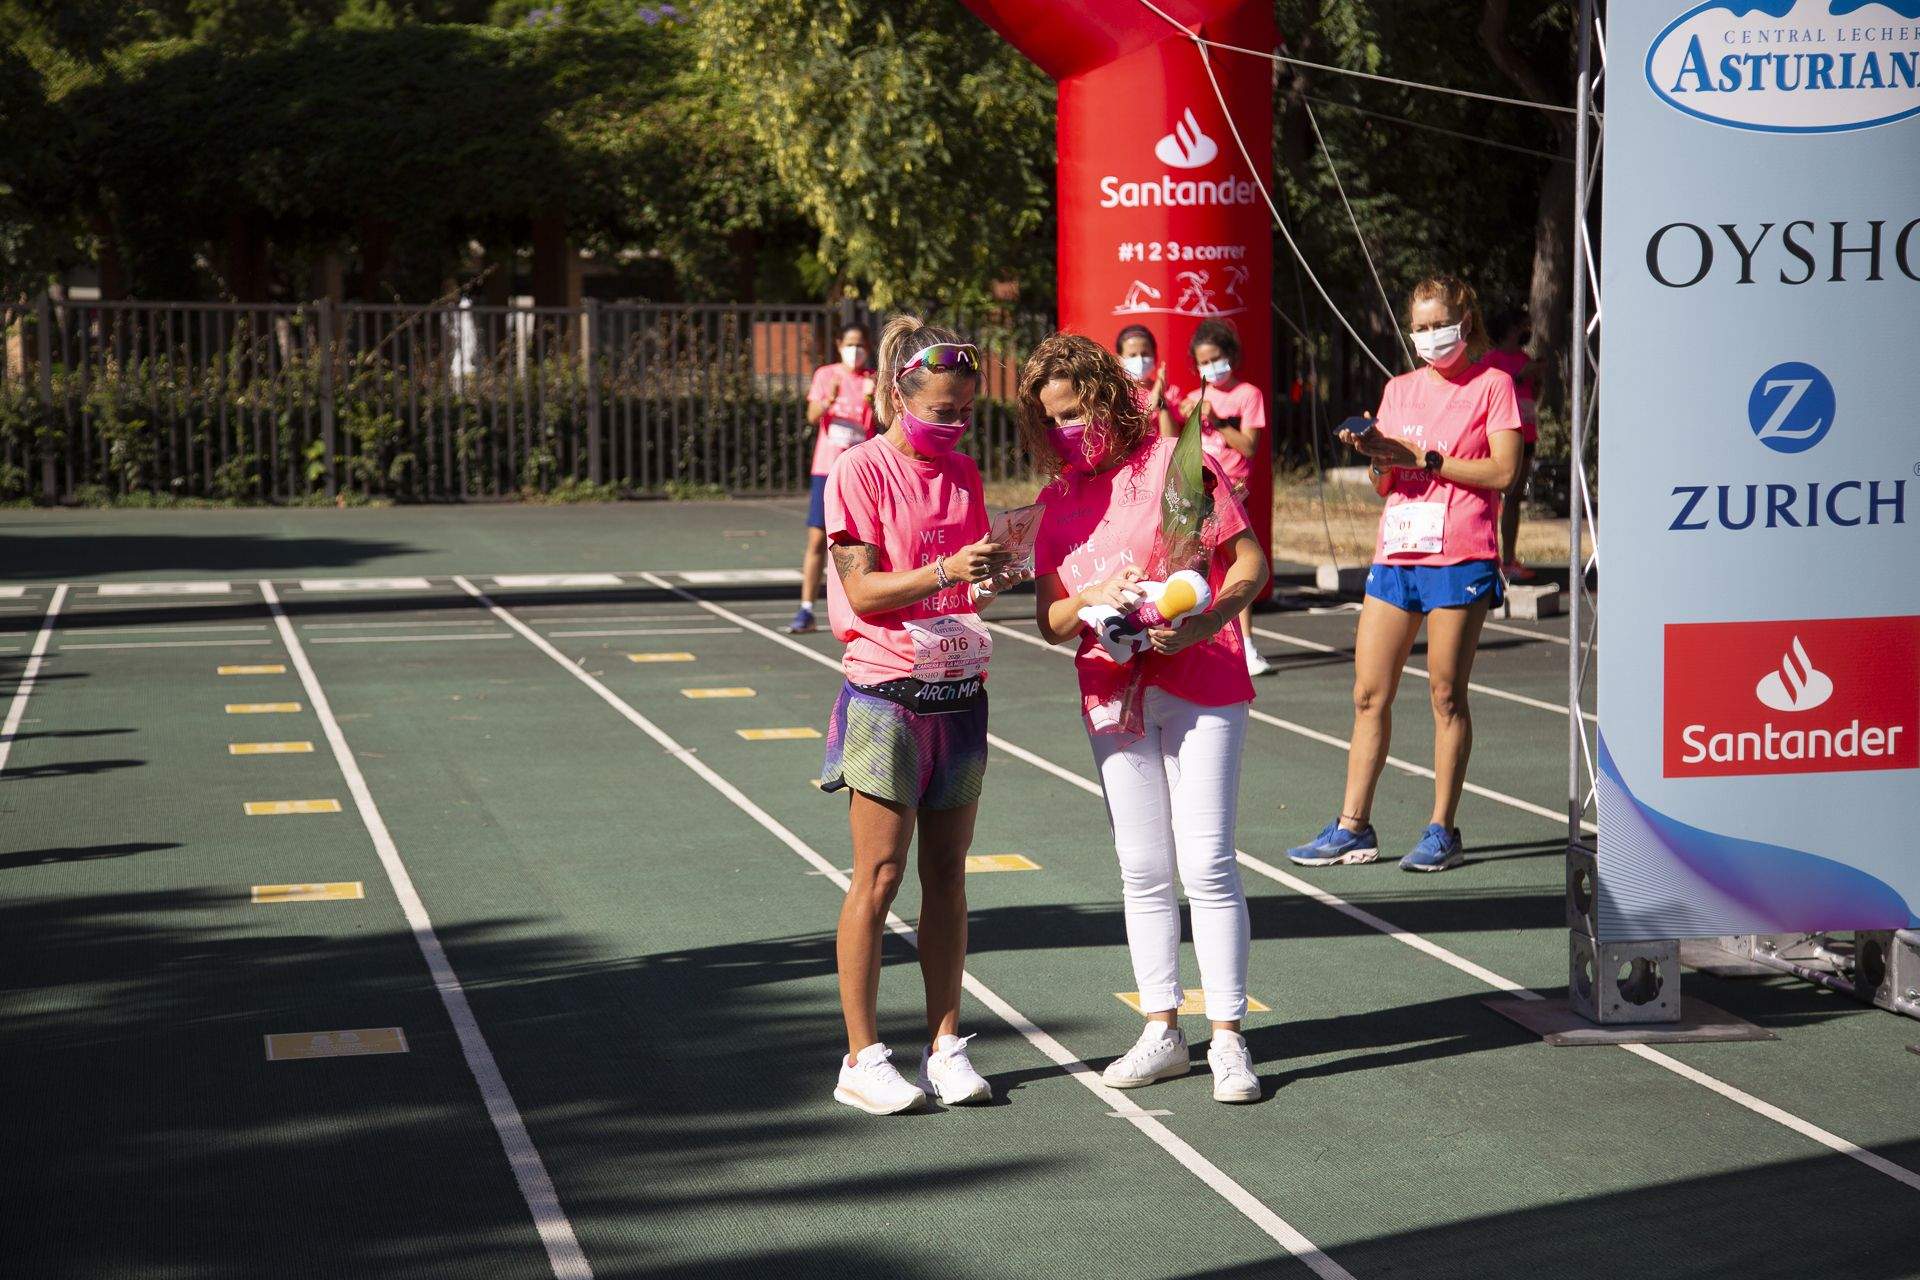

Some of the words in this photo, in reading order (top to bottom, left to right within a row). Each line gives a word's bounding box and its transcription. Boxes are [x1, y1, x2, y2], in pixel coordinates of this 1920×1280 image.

[1724, 28, 1826, 44] CENTRAL
[1670, 34, 1920, 92] ASTURIAN
[1100, 175, 1258, 208] Santander
[1402, 424, 1424, 436] WE
[1668, 480, 1907, 530] ZURICH
[920, 529, 945, 544] WE
[1069, 539, 1095, 555] WE
[1071, 549, 1134, 578] RUN
[922, 595, 970, 611] REASON
[940, 637, 968, 652] 016
[958, 680, 980, 698] MA
[1682, 719, 1904, 764] Santander
